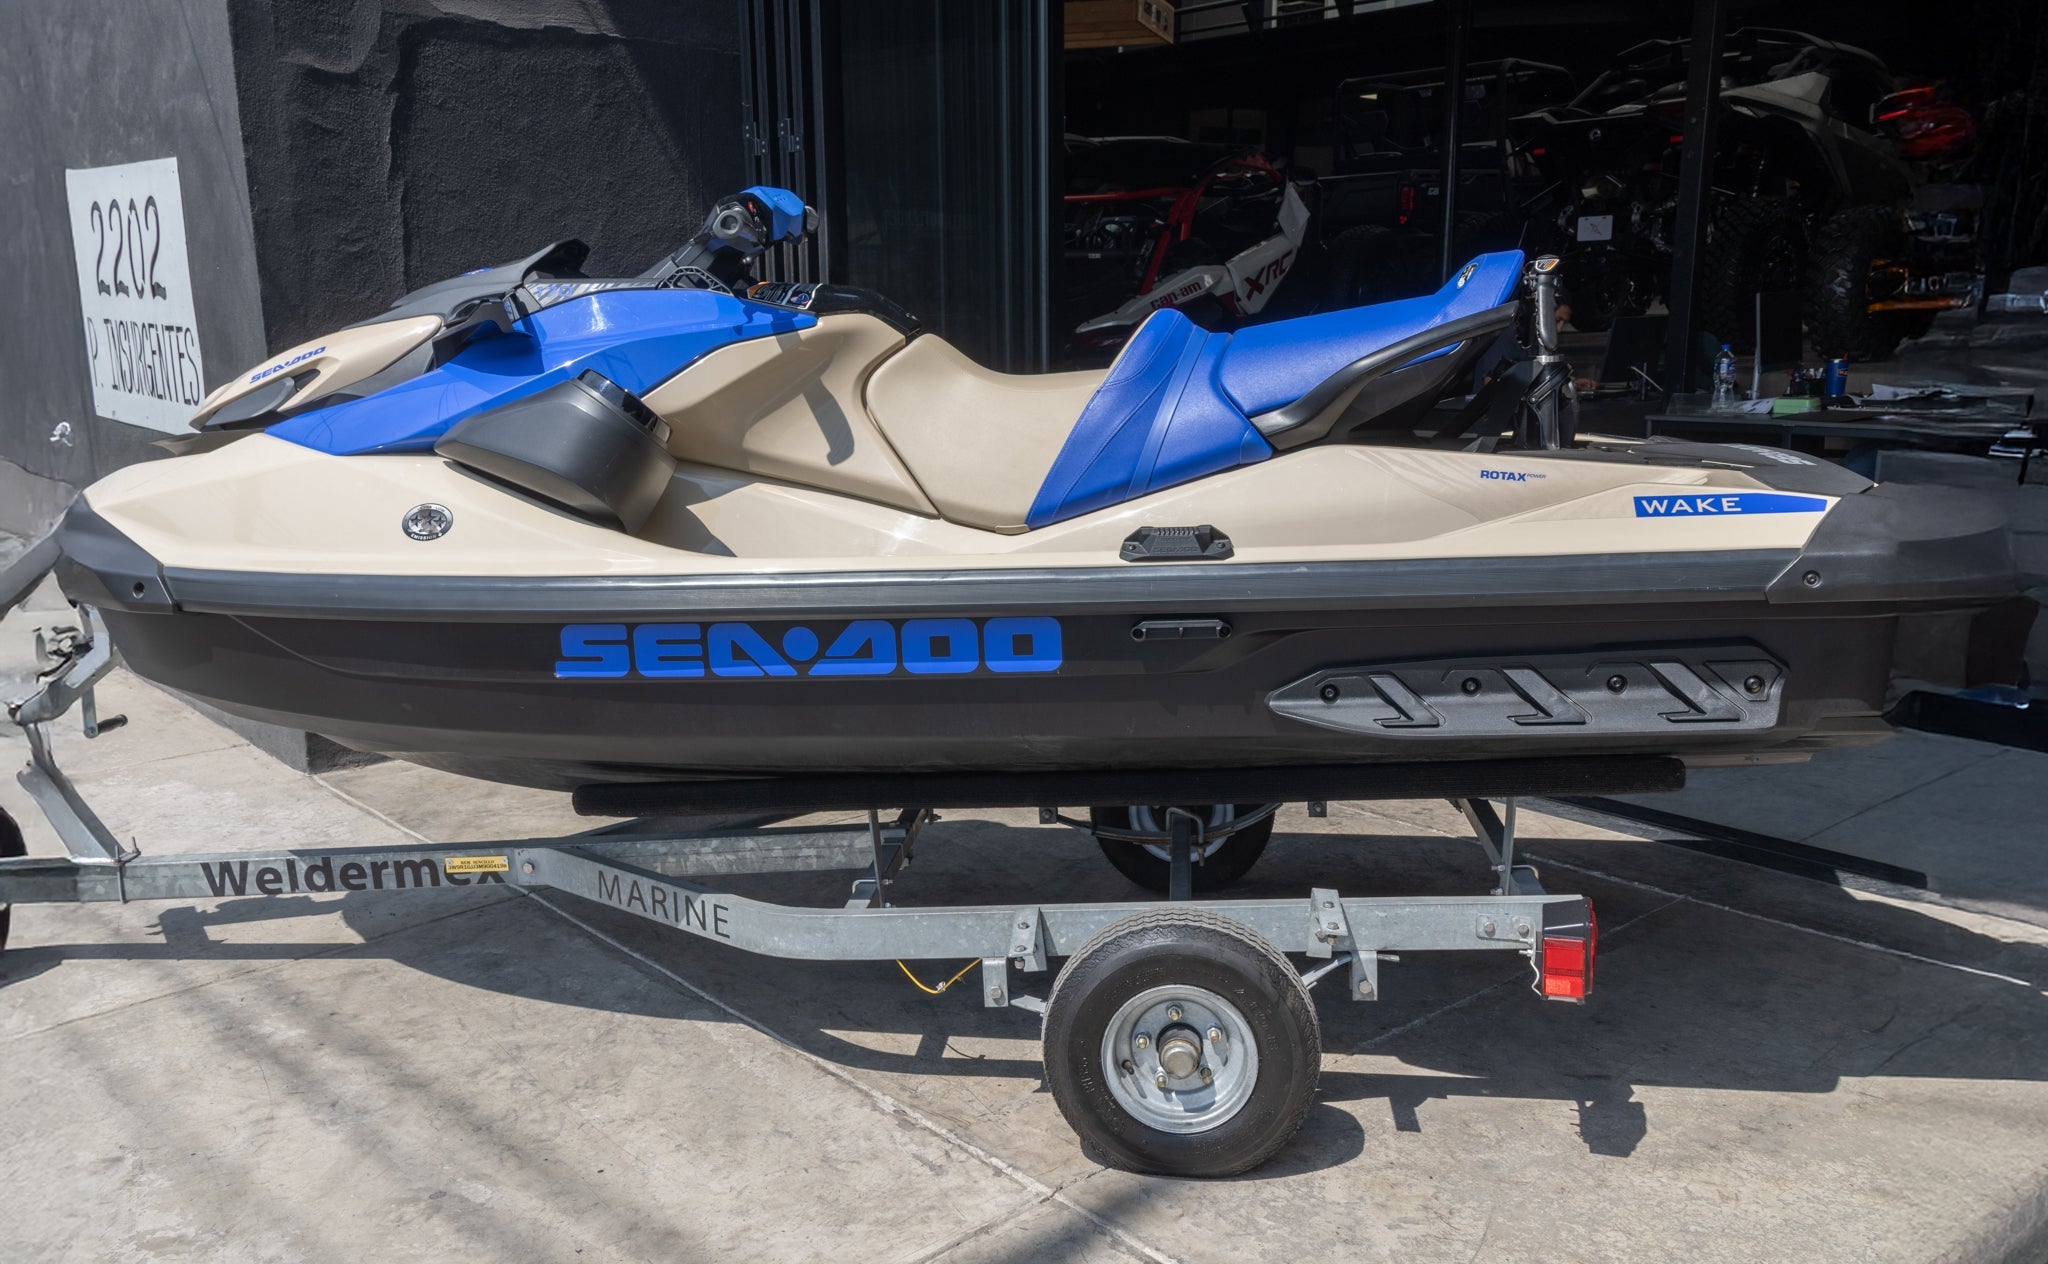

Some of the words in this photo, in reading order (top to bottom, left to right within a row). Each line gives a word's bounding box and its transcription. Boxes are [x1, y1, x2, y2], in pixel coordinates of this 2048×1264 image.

[90, 194, 168, 301] 2202
[1244, 249, 1293, 301] XRC
[103, 318, 201, 406] INSURGENTES
[1480, 469, 1527, 482] ROTAX
[1640, 497, 1743, 514] WAKE
[597, 869, 732, 940] MARINE
